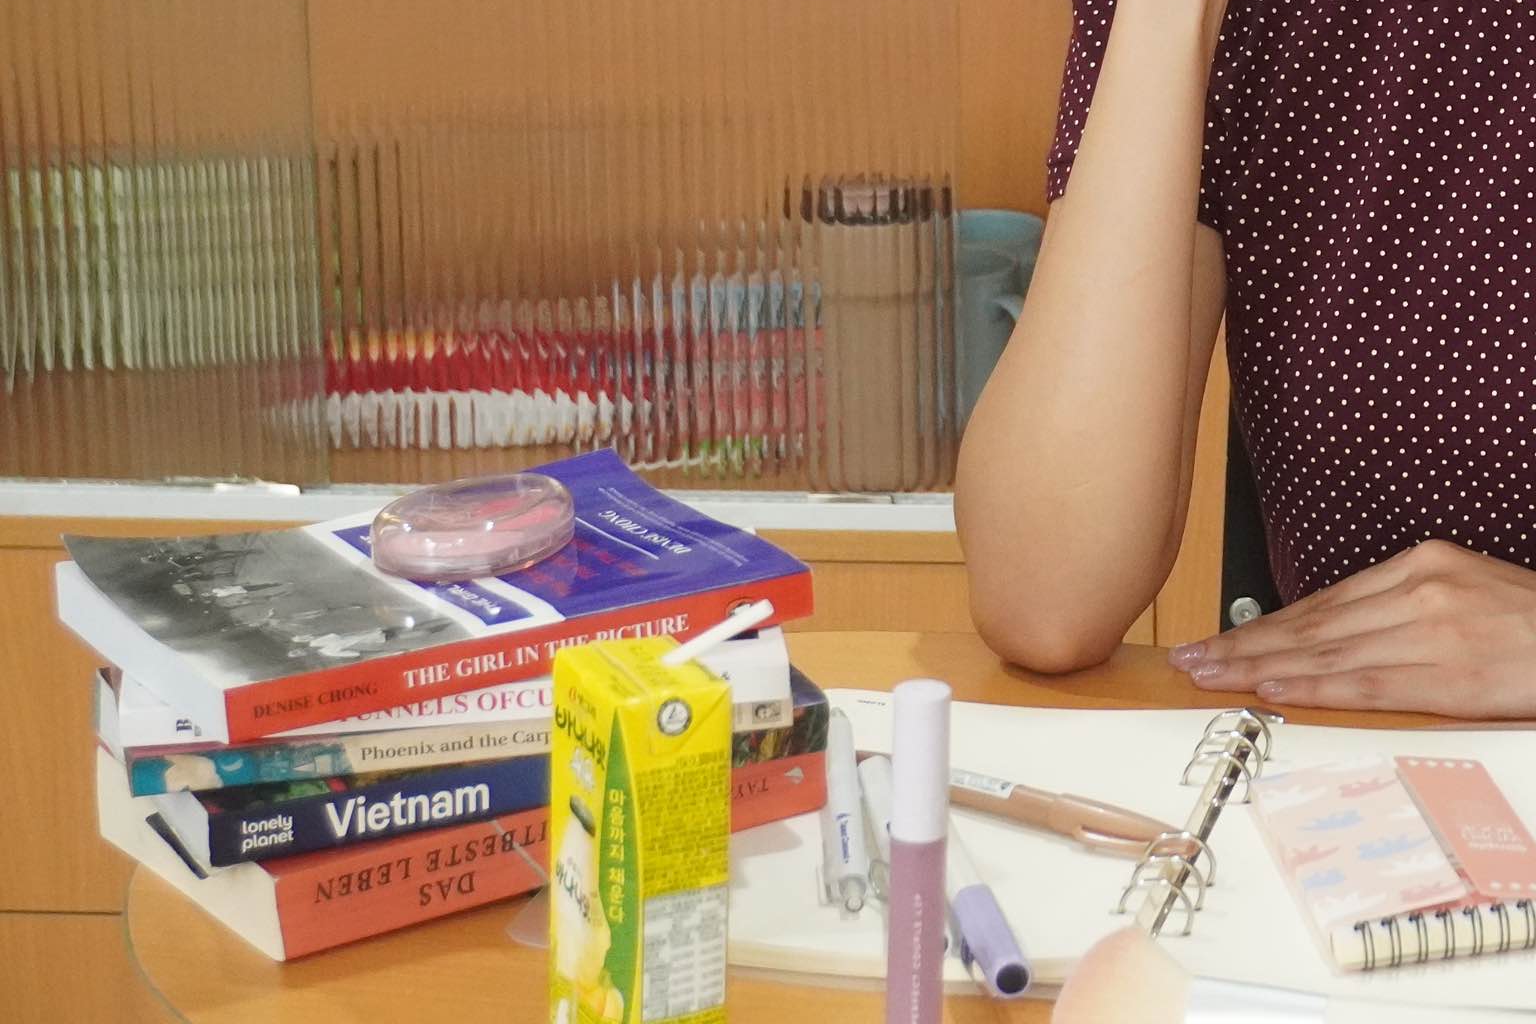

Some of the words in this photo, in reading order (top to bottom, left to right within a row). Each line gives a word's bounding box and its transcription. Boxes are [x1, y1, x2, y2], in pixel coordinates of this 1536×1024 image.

[403, 662, 451, 689] THE
[455, 651, 513, 678] GIRL
[516, 644, 541, 665] IN
[252, 694, 313, 720] DENISE
[318, 682, 379, 705] CHONG
[360, 740, 435, 762] Phoenix
[440, 733, 476, 752] and
[479, 731, 509, 748] the
[241, 814, 294, 835] lonely
[325, 781, 491, 839] Vietnam
[240, 828, 295, 854] planet
[425, 820, 548, 874] ITBESTE
[313, 857, 412, 904] LEBEN
[418, 869, 476, 907] DAS
